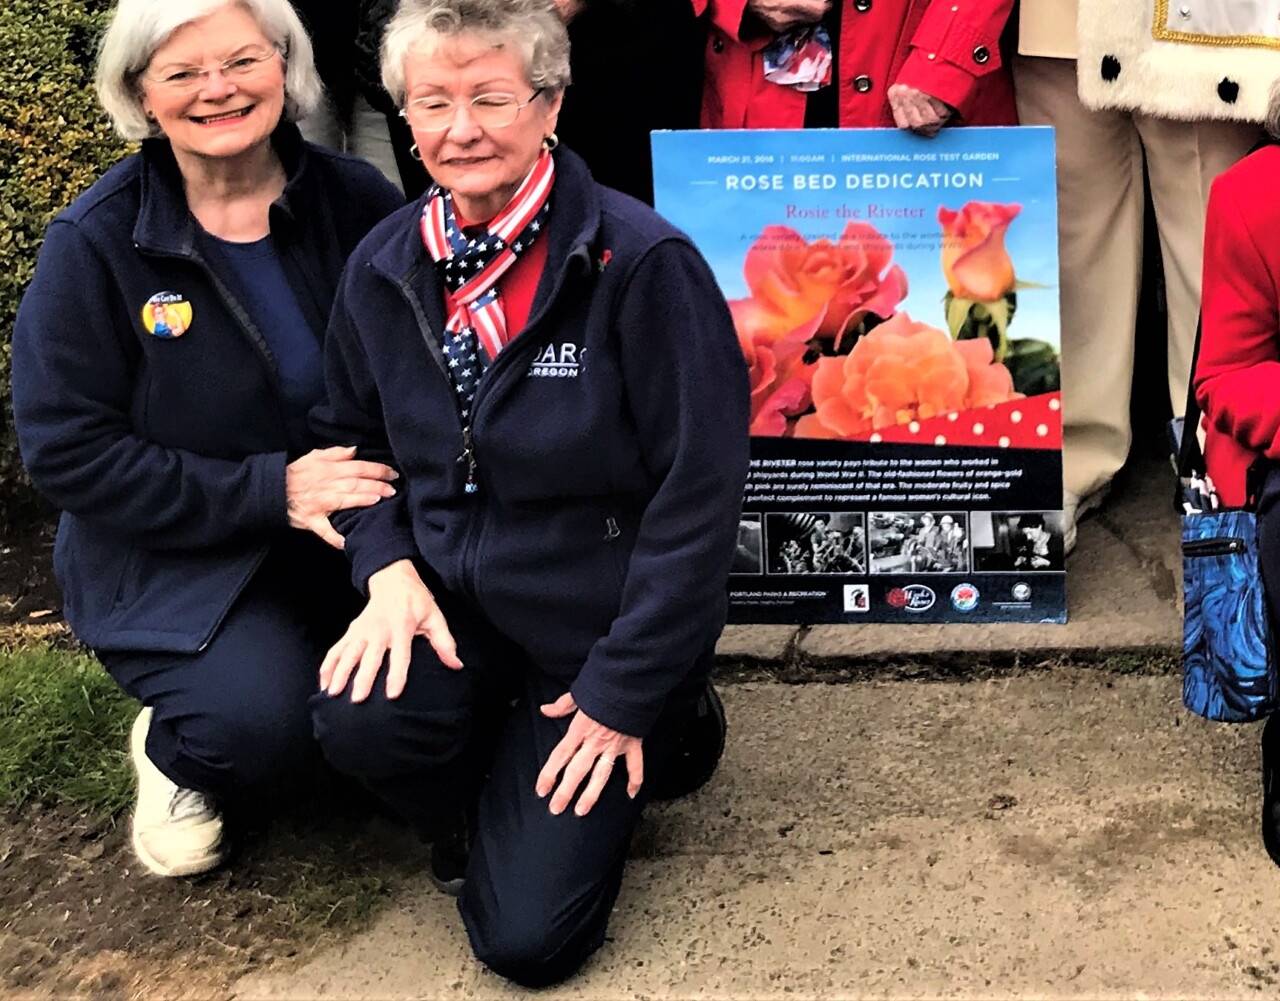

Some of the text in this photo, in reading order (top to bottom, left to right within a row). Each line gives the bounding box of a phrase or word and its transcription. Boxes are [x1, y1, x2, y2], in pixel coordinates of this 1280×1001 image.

[708, 155, 740, 164] MARCH
[841, 153, 911, 162] INTERNATIONAL
[913, 153, 937, 162] ROSE
[939, 153, 961, 161] TEST
[961, 152, 1000, 161] GARDEN
[725, 171, 984, 191] ROSE BED DEDICATION
[785, 203, 926, 219] Rosie the Riveter
[762, 459, 797, 468] RIVETER
[798, 460, 815, 468] rose
[815, 459, 842, 469] variety
[843, 460, 861, 469] pays
[889, 459, 899, 467] to
[899, 458, 913, 467] the
[943, 458, 960, 467] who
[961, 458, 990, 467] worked
[990, 458, 999, 466] in
[753, 471, 788, 480] shipyards
[789, 471, 815, 480] during
[816, 470, 840, 479] World
[841, 470, 857, 479] War
[868, 470, 882, 478] The
[965, 469, 975, 477] of
[754, 483, 771, 492] pink
[855, 481, 864, 490] of
[865, 482, 880, 490] that
[898, 481, 913, 490] The
[914, 481, 951, 490] moderate
[974, 480, 990, 490] and
[824, 493, 833, 501] to
[729, 590, 762, 598] PORTLAND
[788, 590, 827, 598] RECREATION
